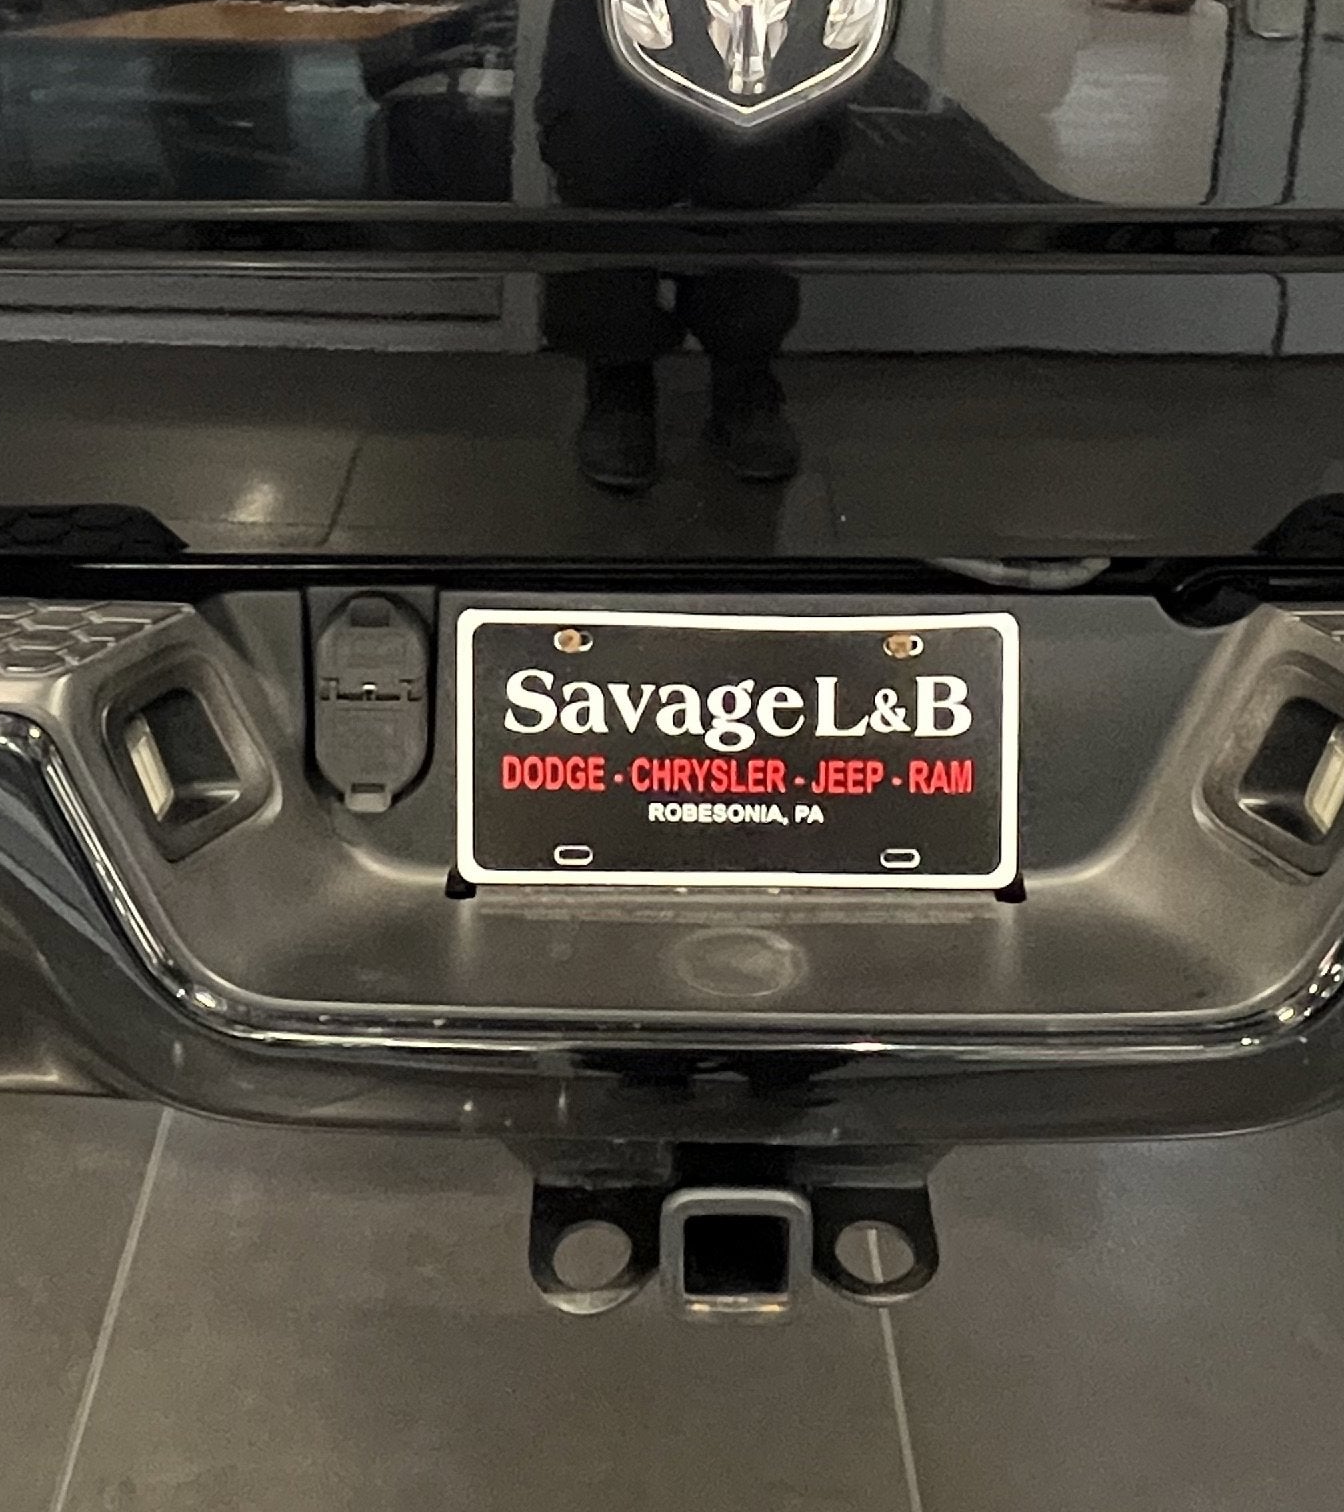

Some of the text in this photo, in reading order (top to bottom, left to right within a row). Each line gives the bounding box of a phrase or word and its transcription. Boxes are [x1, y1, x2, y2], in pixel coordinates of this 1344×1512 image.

[502, 754, 606, 792] DODGE
[630, 756, 786, 794] CHRYSLER
[810, 759, 885, 795] JEEP
[908, 759, 973, 795] RAM
[648, 801, 825, 826] ROBESONIA, PA
